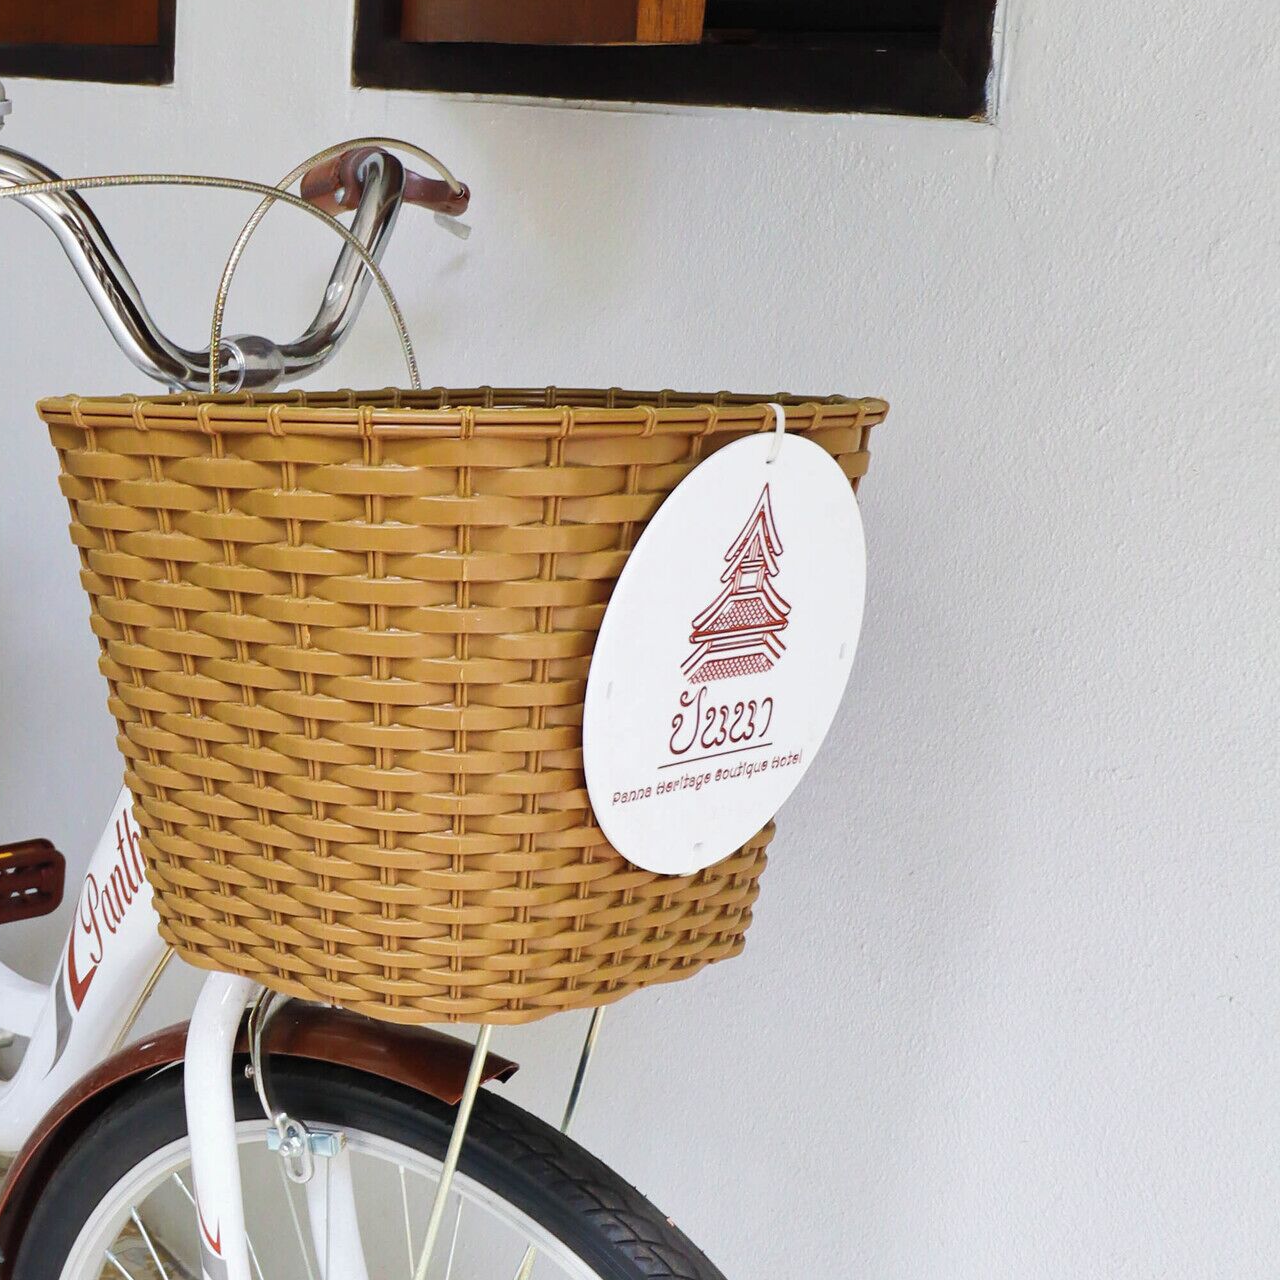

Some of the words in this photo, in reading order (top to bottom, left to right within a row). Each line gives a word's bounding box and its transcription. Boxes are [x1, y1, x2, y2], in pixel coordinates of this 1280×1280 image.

[612, 785, 652, 806] Panna
[656, 771, 711, 796] Heritage
[714, 759, 768, 782] Boutique
[771, 748, 803, 770] Hotel
[81, 807, 148, 964] Panth
